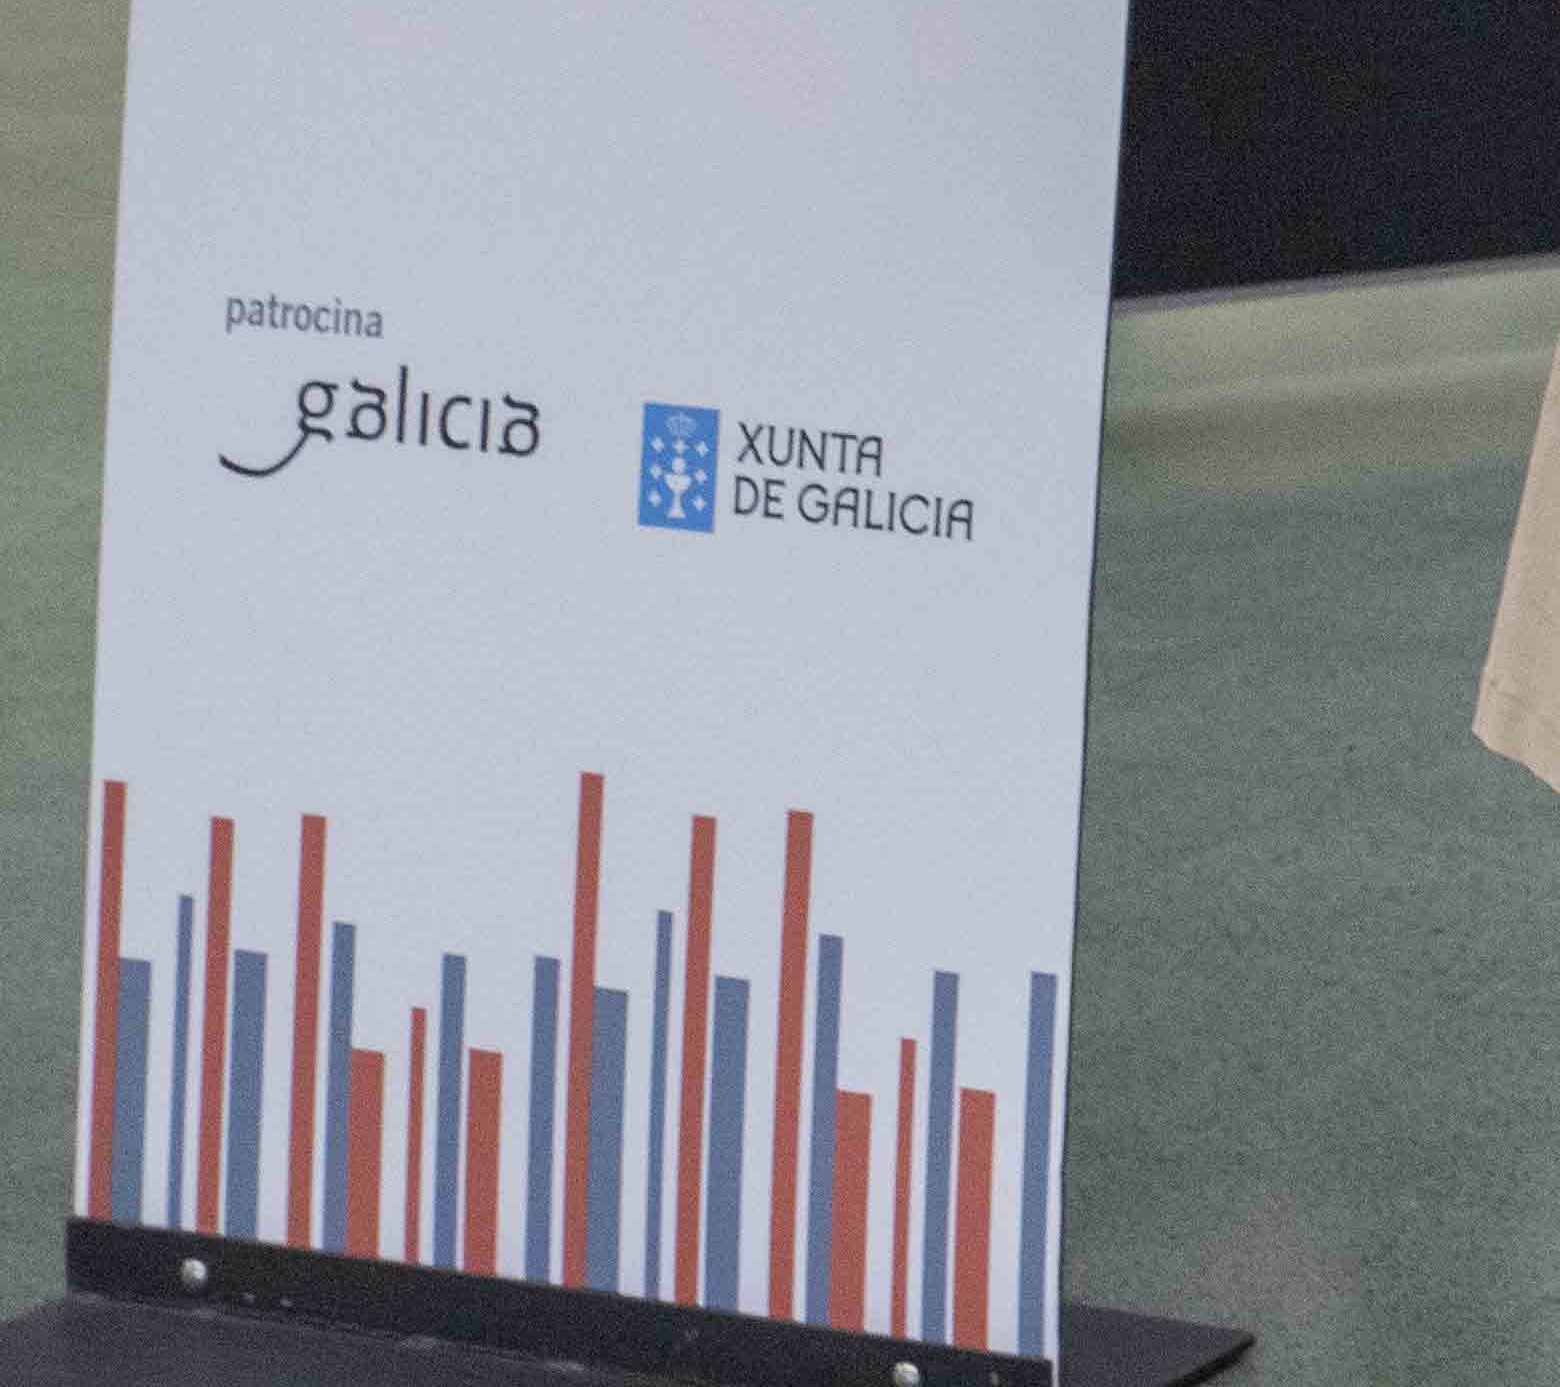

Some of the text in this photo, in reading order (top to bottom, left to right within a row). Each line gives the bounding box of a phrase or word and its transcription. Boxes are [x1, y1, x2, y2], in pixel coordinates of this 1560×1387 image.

[225, 294, 385, 340] patrocina
[219, 365, 541, 477] galicia
[737, 422, 885, 478] XUNTA
[733, 475, 977, 540] DE GALICIA
